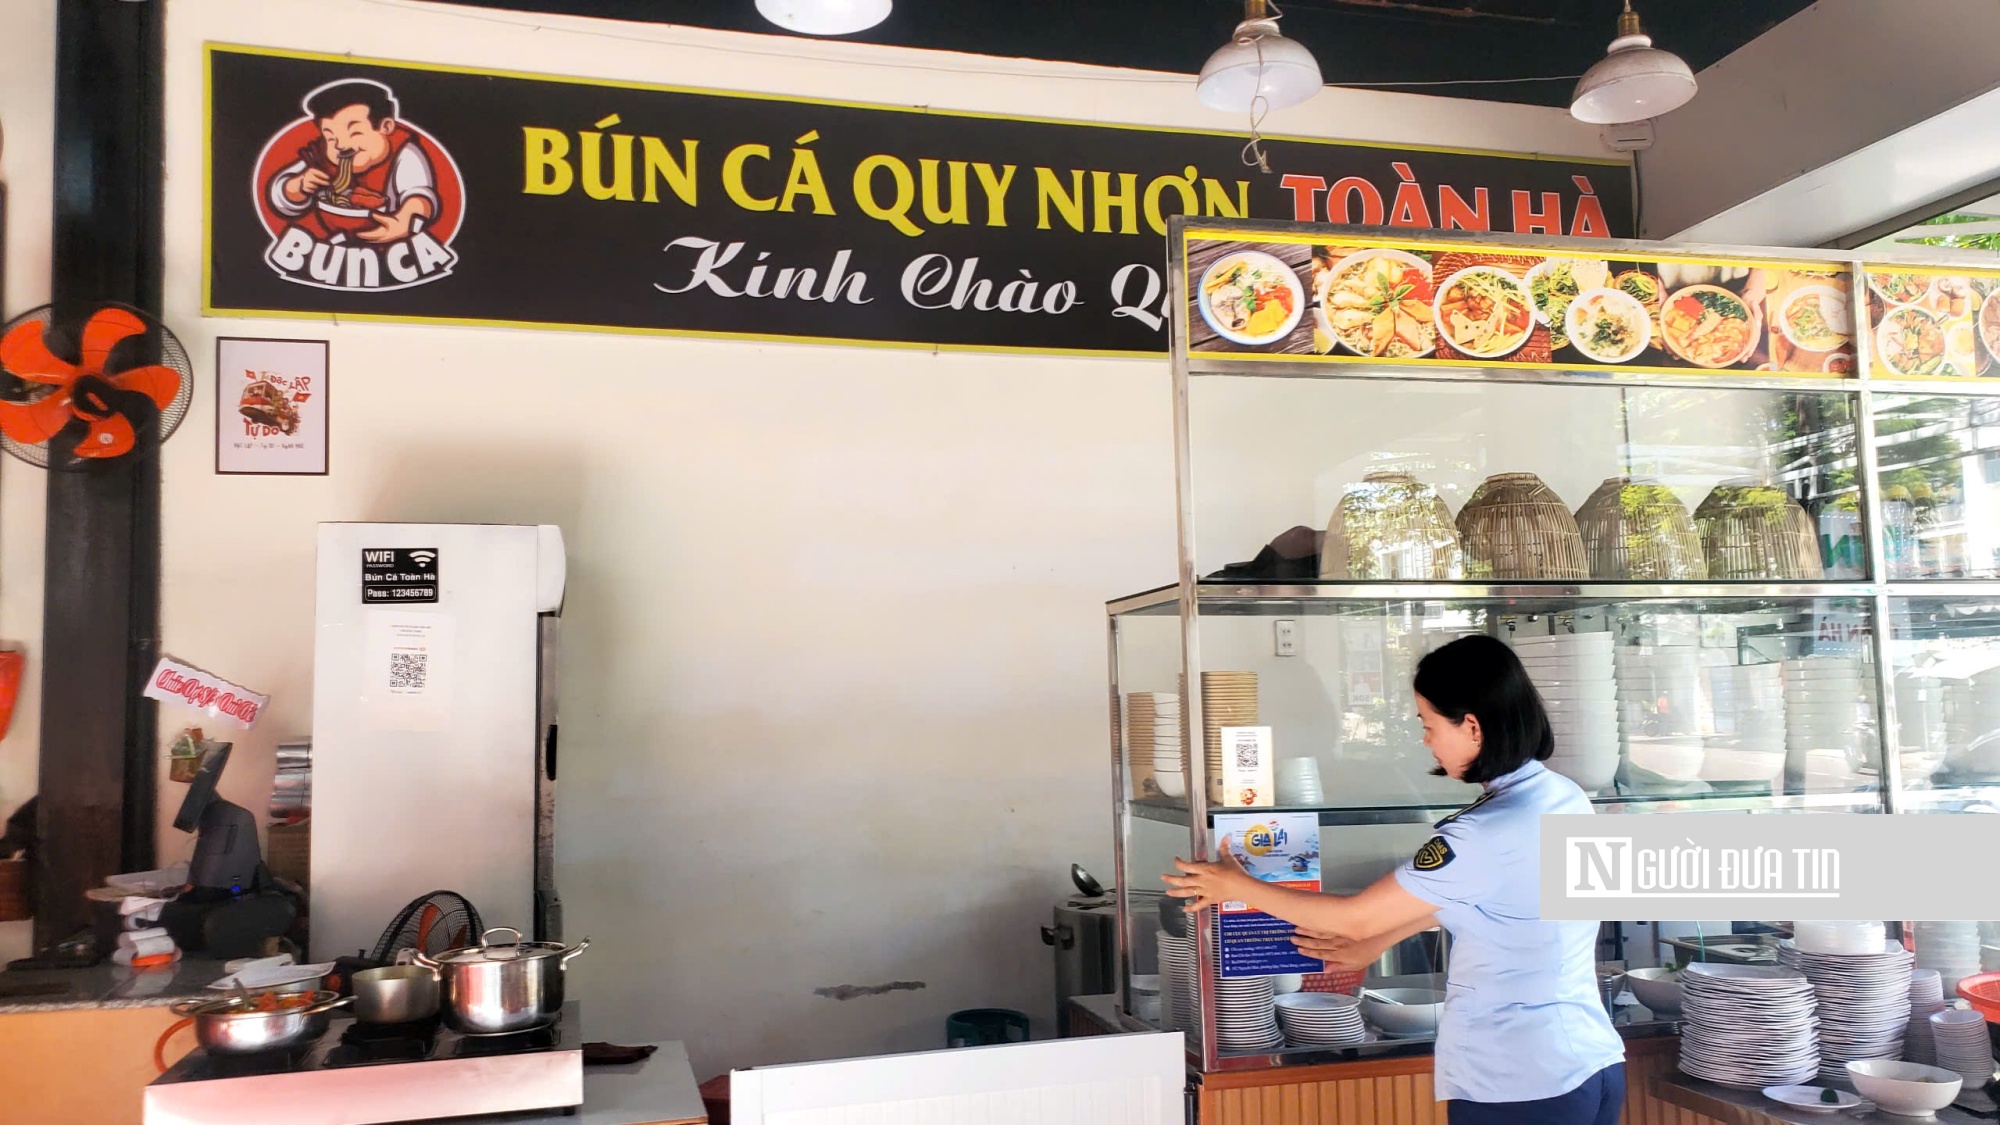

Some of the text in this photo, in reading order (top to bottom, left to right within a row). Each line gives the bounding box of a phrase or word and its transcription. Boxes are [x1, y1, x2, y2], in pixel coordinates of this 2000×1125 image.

[522, 113, 699, 208] BÚN
[721, 130, 837, 216] CÁ
[853, 154, 1017, 237] QUY
[387, 218, 450, 282] CÁ
[653, 236, 874, 305] Kính
[899, 252, 1085, 315] Chào
[262, 425, 279, 437] DO
[365, 551, 394, 562] WIFI
[365, 572, 435, 581] Bún Cá Toàn Hà
[367, 588, 433, 597] Pass: 123456789
[1251, 833, 1271, 847] GIA
